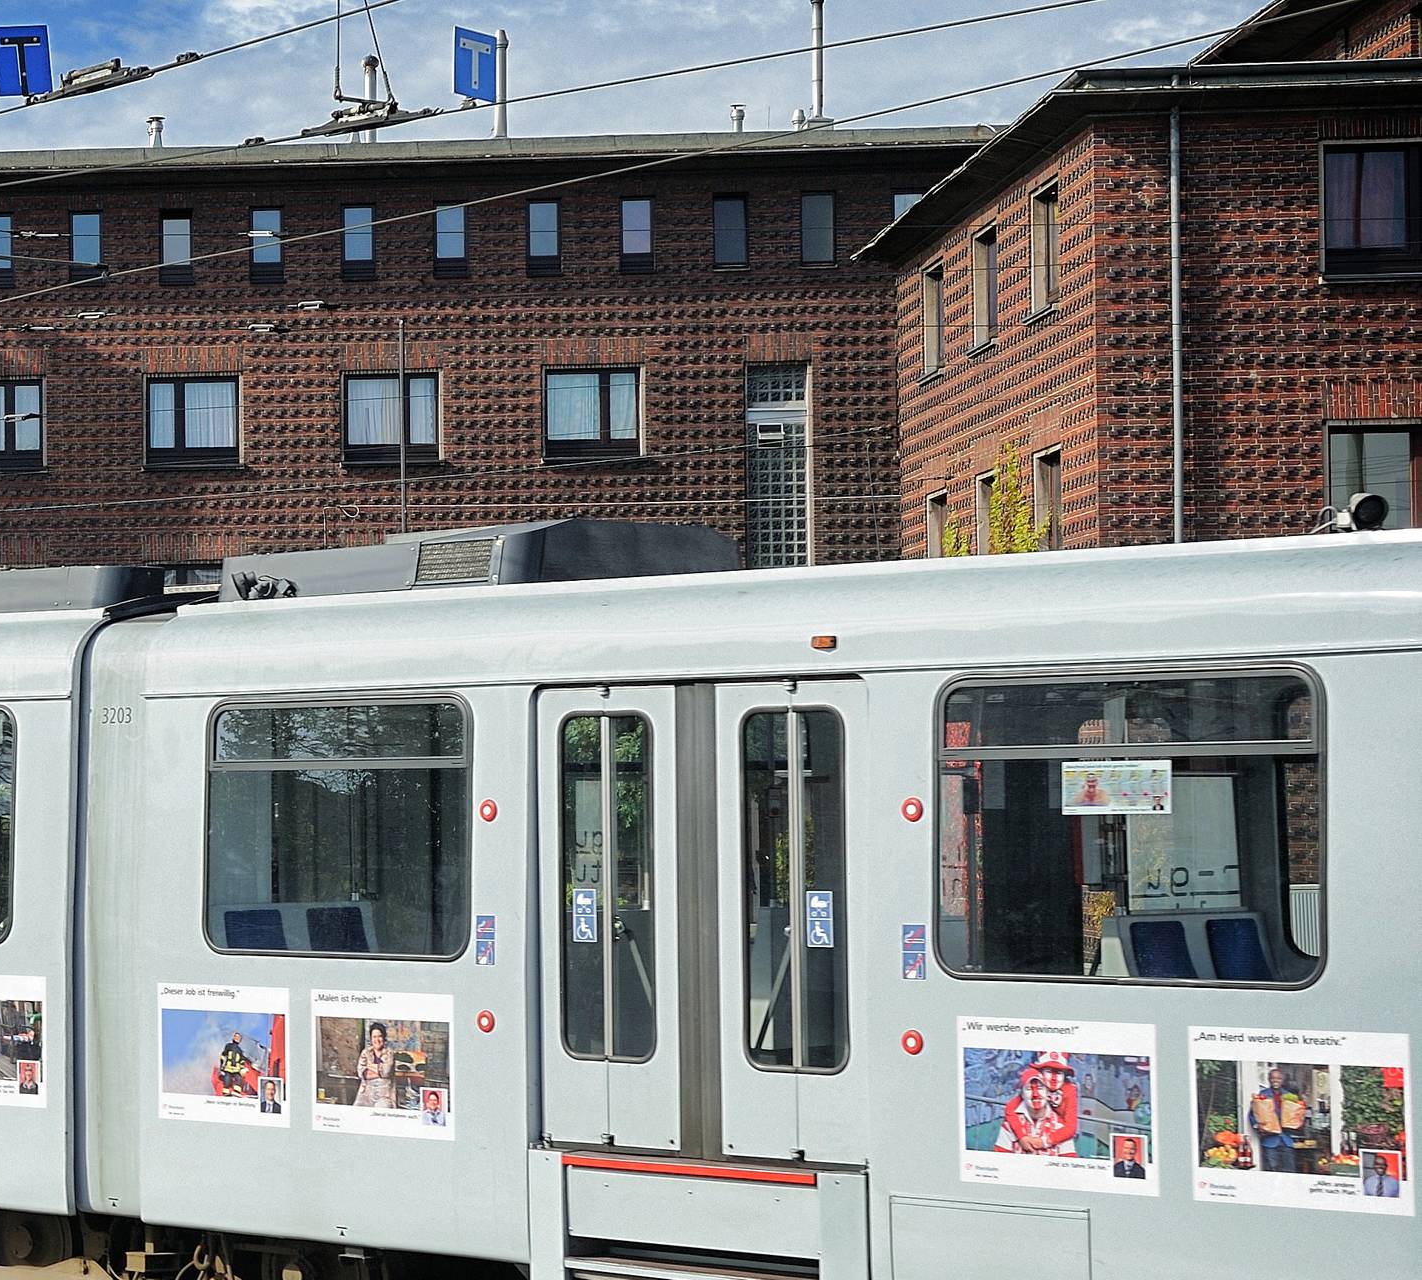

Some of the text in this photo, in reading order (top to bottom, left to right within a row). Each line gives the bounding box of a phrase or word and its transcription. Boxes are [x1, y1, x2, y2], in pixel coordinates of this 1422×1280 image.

[101, 706, 133, 725] 3203
[986, 1023, 1021, 1032] werden
[1219, 1032, 1244, 1042] Herd
[1247, 1034, 1281, 1044] werde
[1283, 1034, 1300, 1045] ich
